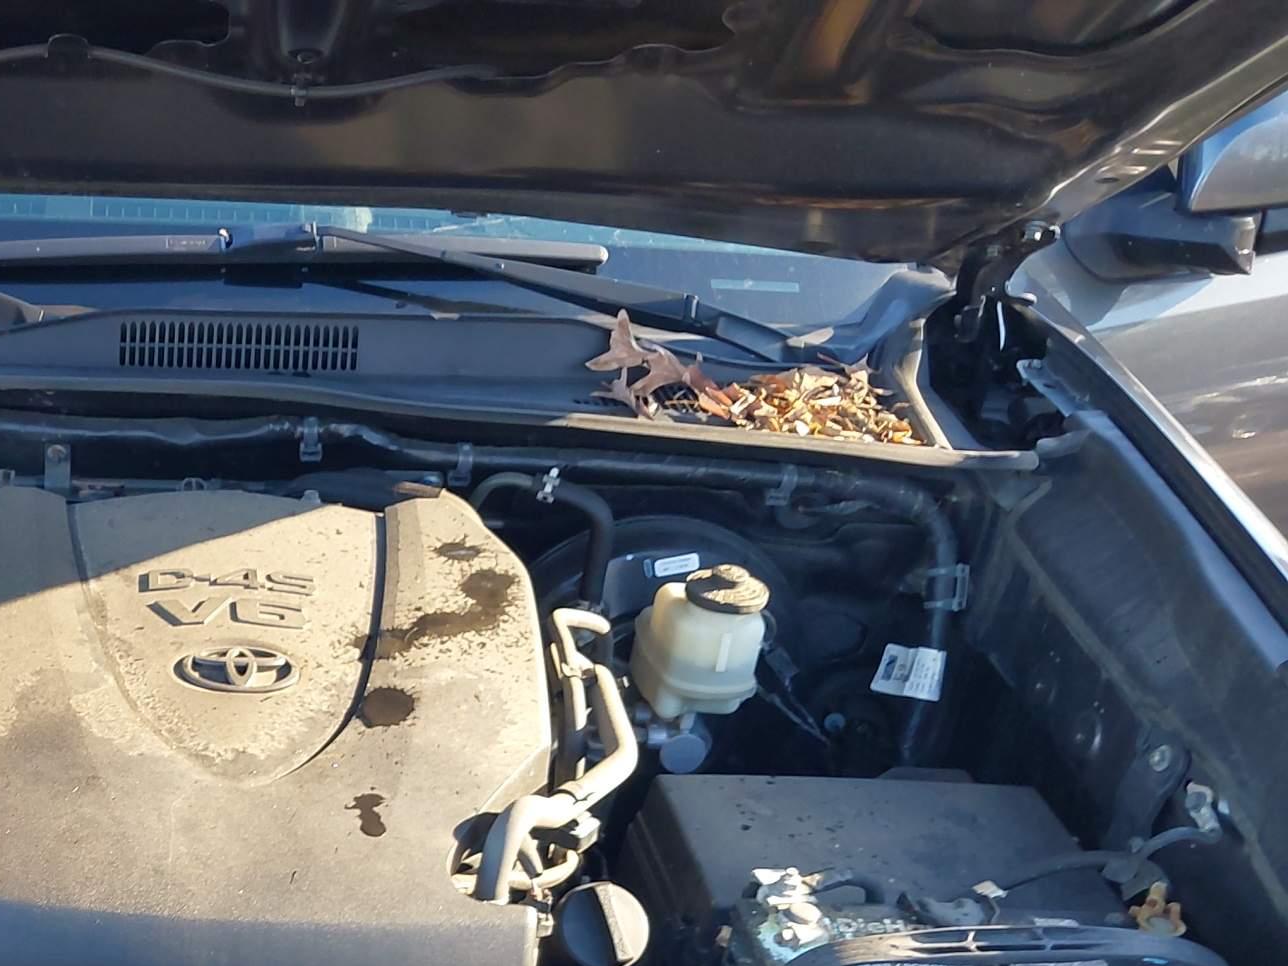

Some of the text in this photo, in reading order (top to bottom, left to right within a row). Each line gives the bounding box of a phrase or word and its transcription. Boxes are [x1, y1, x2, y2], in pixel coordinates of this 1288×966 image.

[138, 567, 317, 597] D-4S
[145, 595, 312, 630] V6
[836, 917, 910, 933] DieH
